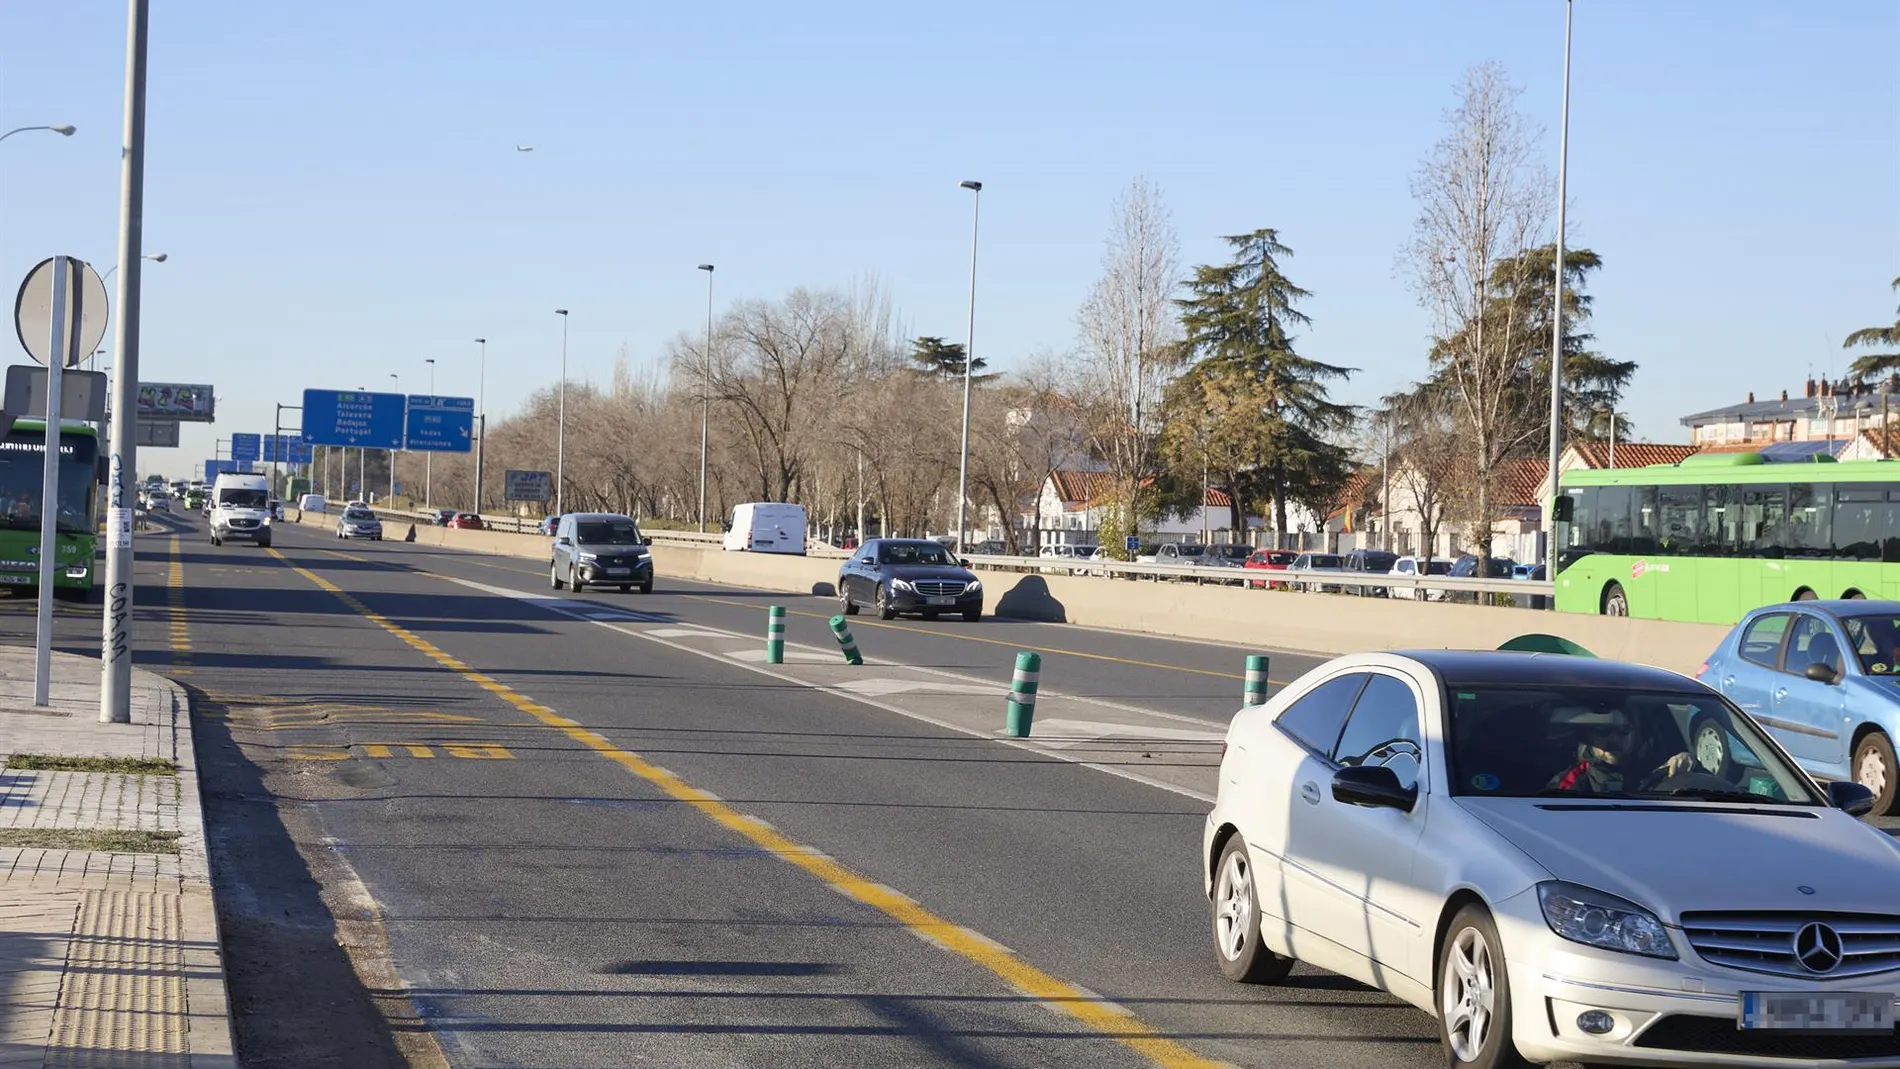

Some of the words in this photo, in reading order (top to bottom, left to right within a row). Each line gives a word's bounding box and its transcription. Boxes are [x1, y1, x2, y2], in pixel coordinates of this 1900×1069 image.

[337, 403, 373, 411] Alcorcón
[337, 411, 372, 419] Talavera
[336, 418, 367, 428] Badajoz
[335, 426, 372, 437] Portugal
